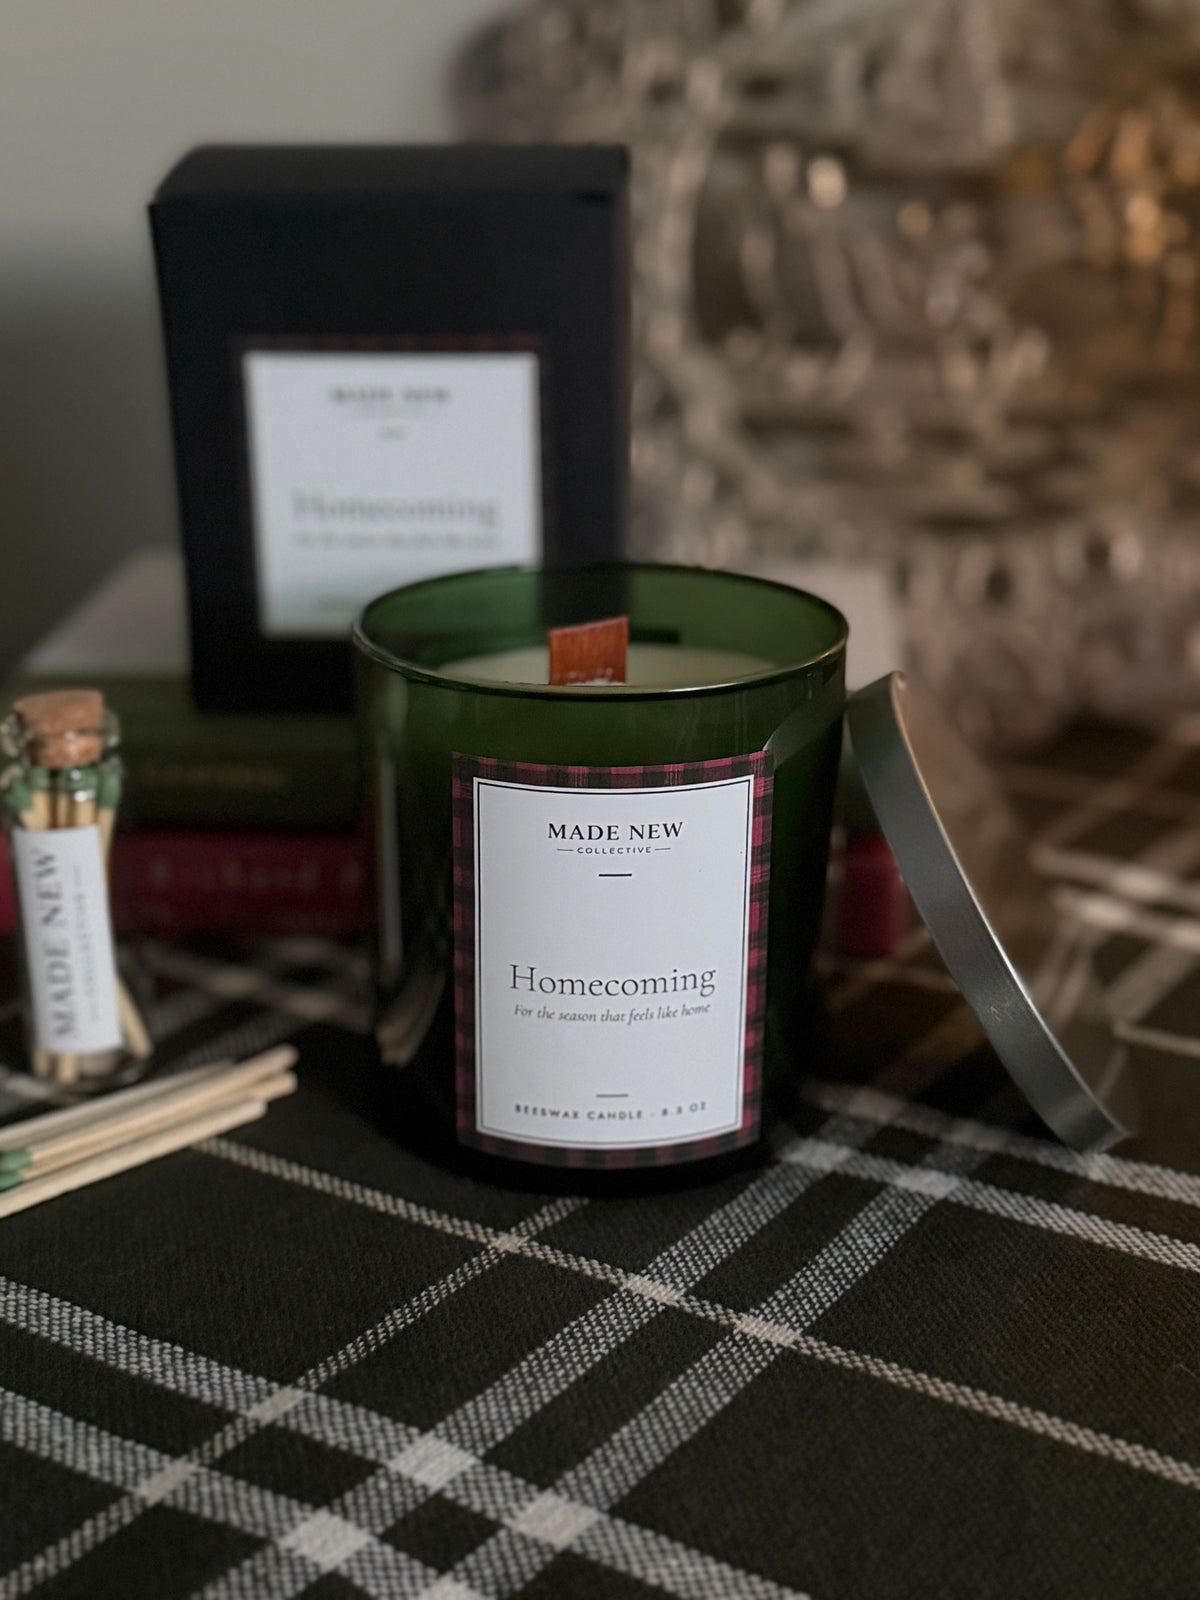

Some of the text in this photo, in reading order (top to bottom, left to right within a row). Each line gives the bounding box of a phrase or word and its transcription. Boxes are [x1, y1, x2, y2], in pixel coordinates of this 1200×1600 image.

[548, 821, 683, 841] MADE NEW
[576, 846, 653, 855] COLLECTIVE
[30, 847, 79, 1038] MADE NEW
[509, 963, 717, 998] Homecoming
[514, 1003, 712, 1027] For the season that feels like home
[514, 1102, 580, 1120] BEESWAX
[586, 1109, 644, 1121] CANDLE
